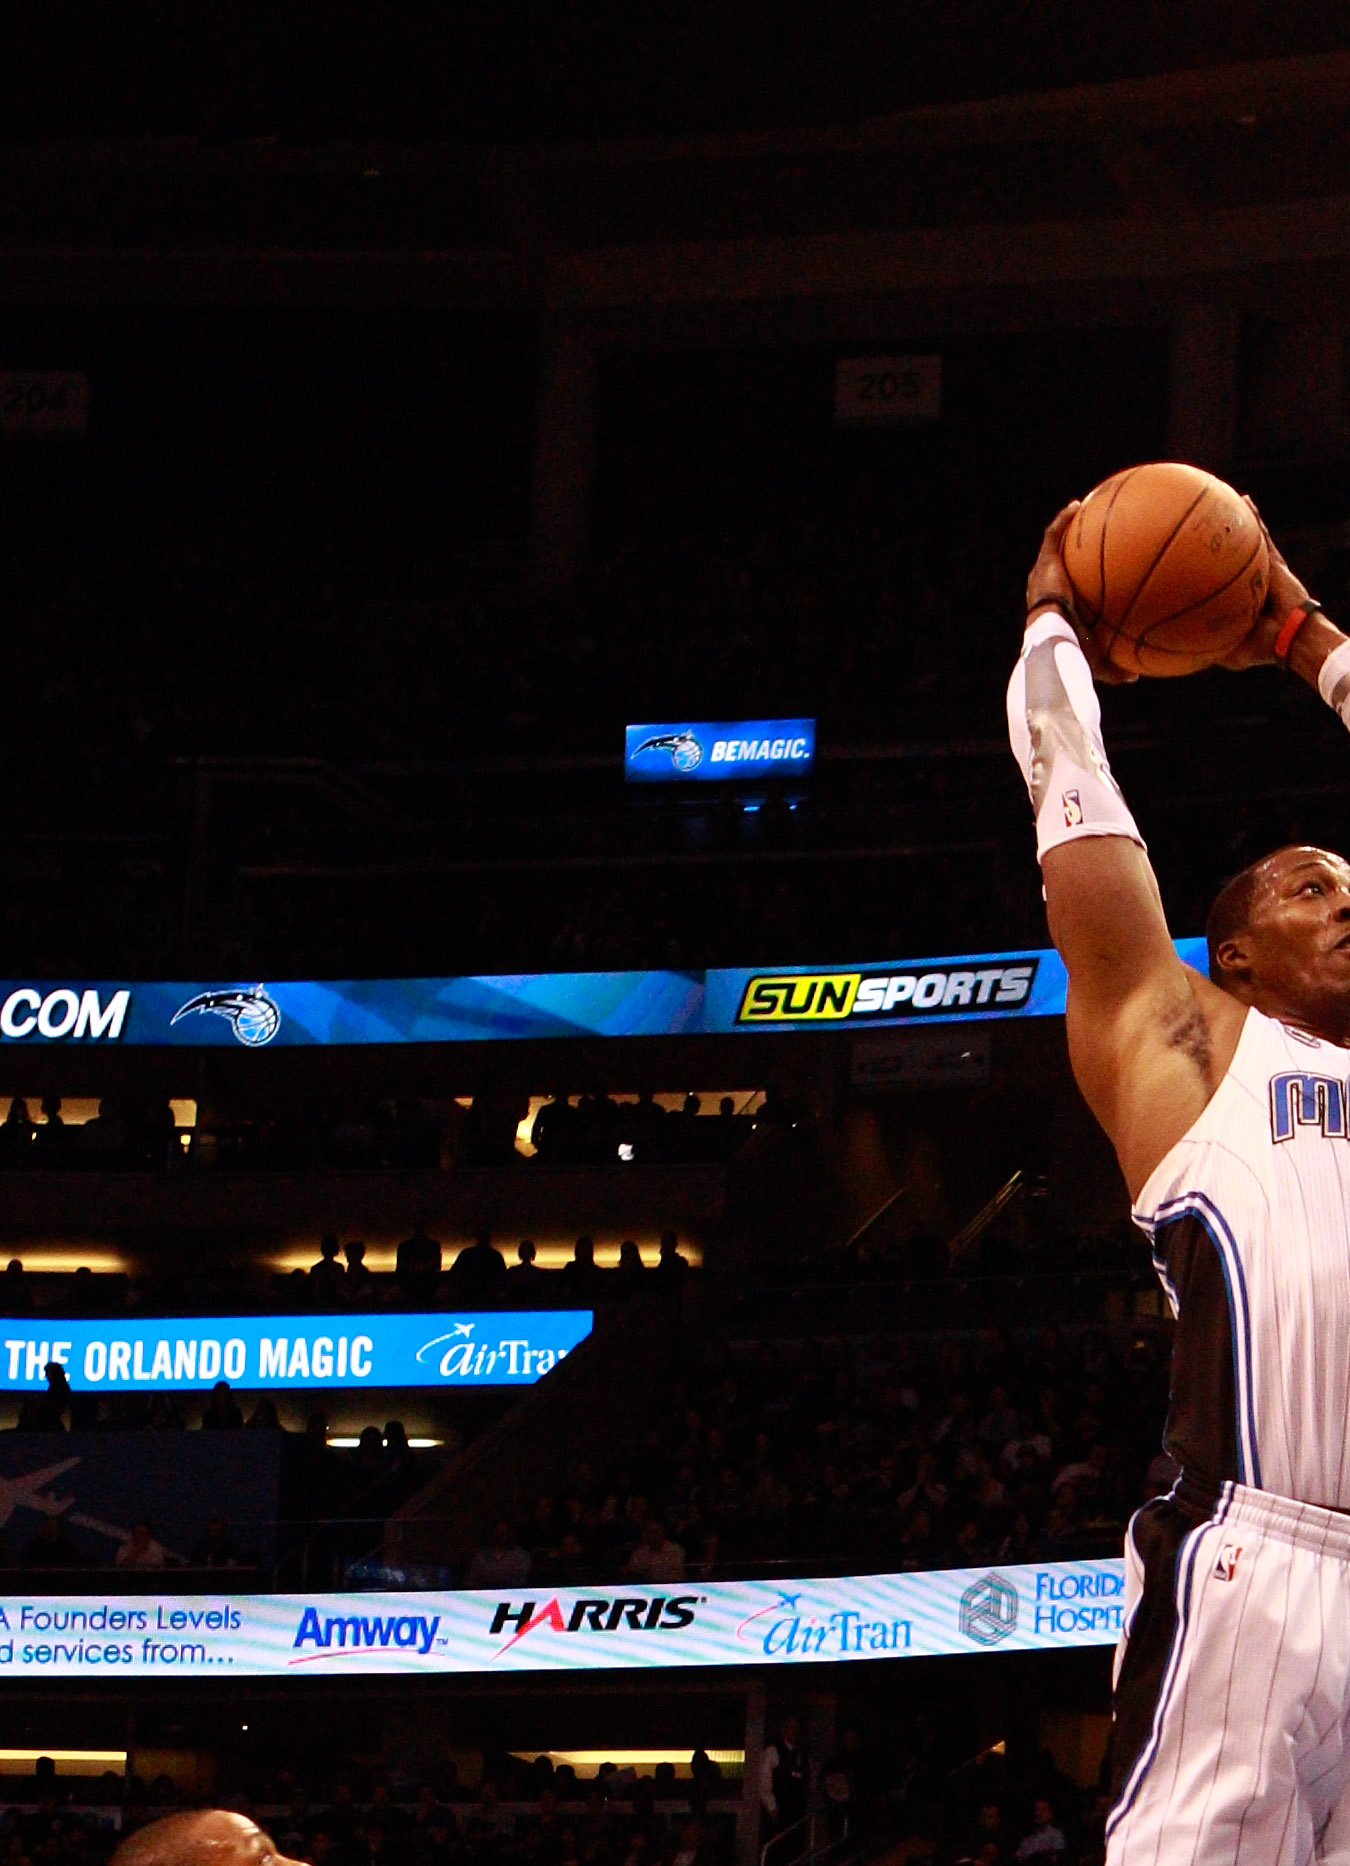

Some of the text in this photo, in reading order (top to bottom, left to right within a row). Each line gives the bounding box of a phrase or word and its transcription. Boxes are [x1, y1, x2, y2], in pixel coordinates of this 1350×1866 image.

[4, 1336, 373, 1381] THE ORLANDO MAGIC
[20, 1605, 148, 1631] Founders
[156, 1605, 242, 1630] Levels
[293, 1607, 442, 1654] Amway
[489, 1597, 699, 1636] HARRIS
[762, 1610, 913, 1656] airTran
[22, 1638, 134, 1664] services
[142, 1637, 235, 1664] from...
